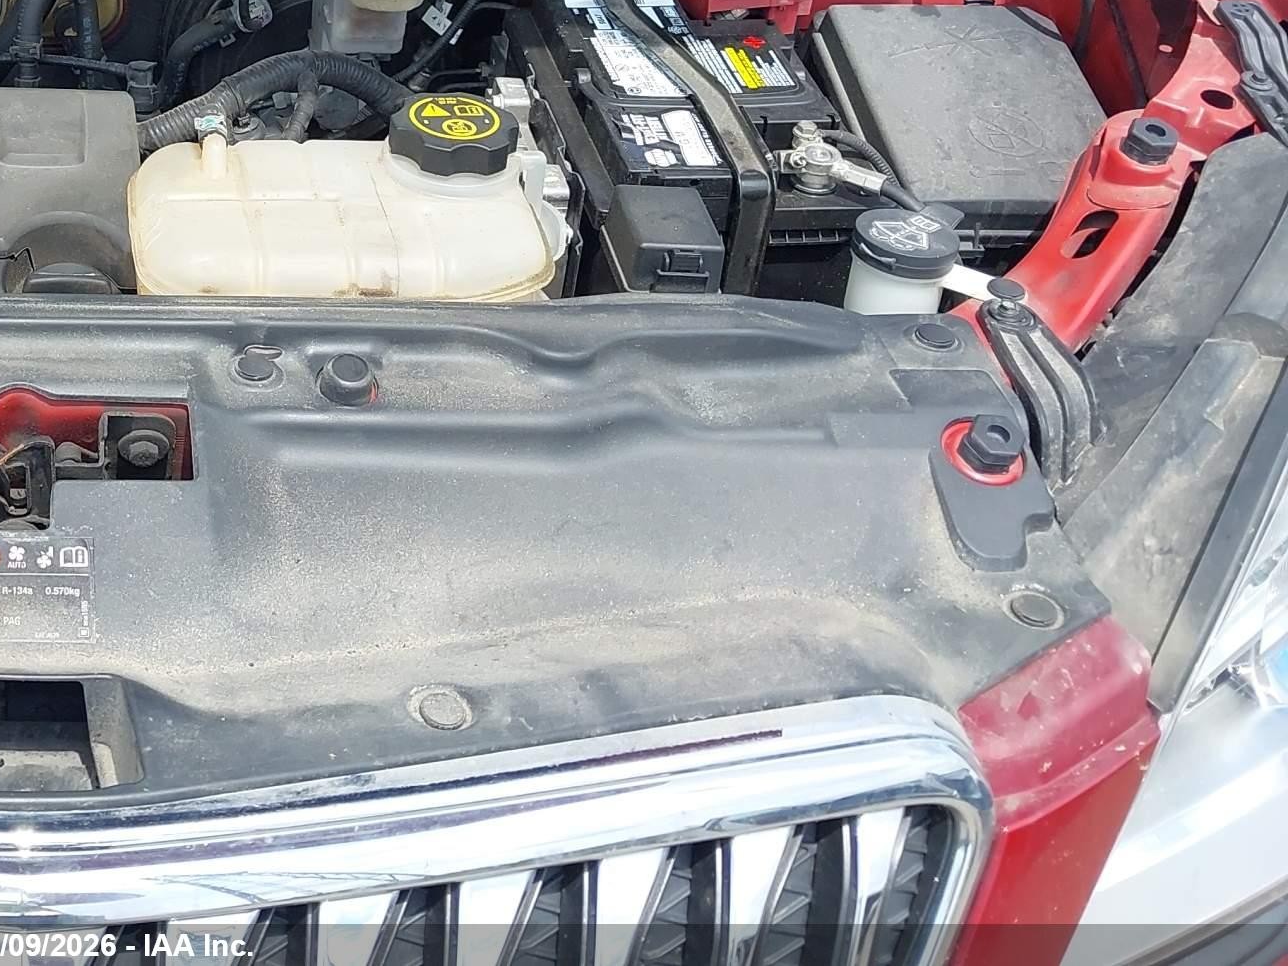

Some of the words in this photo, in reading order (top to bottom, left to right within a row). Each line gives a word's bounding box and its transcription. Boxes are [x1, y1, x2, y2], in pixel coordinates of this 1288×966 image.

[7, 561, 27, 569] AUTO
[1, 586, 34, 596] R-134a
[44, 586, 81, 597] 0.570kg
[3, 616, 21, 626] PAG
